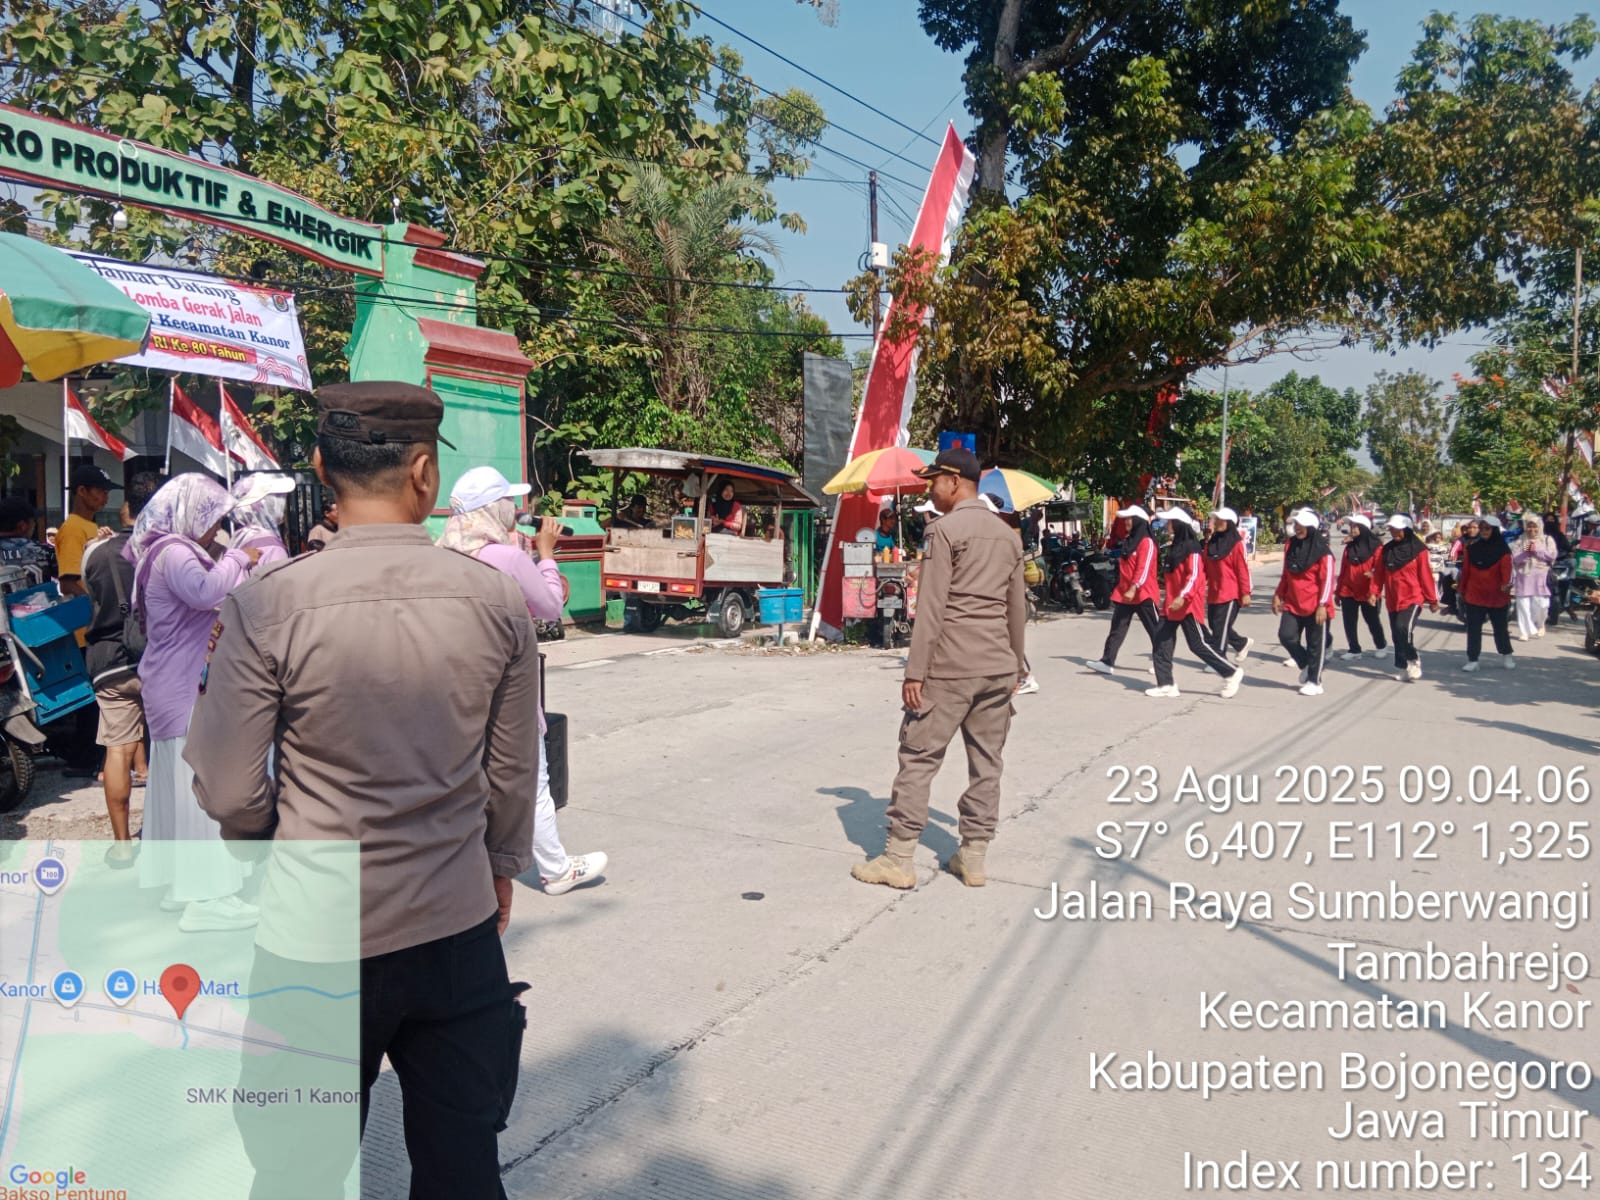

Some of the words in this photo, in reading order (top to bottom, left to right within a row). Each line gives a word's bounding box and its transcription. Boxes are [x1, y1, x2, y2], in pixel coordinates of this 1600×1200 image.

[0, 122, 43, 161] RO
[51, 136, 228, 208] PRODUKTIF
[237, 189, 257, 217] &
[266, 200, 373, 260] ENERGIK
[83, 259, 159, 286] lamat
[158, 274, 241, 305] Datang
[122, 285, 180, 311] Lomba
[181, 297, 227, 320] Gerak
[228, 304, 263, 328] Jalan
[152, 335, 168, 350] RI
[170, 337, 189, 353] Ke
[191, 339, 208, 355] 80
[210, 344, 247, 362] Tahun
[157, 313, 246, 341] Kecamatan
[247, 328, 291, 350] Kanor
